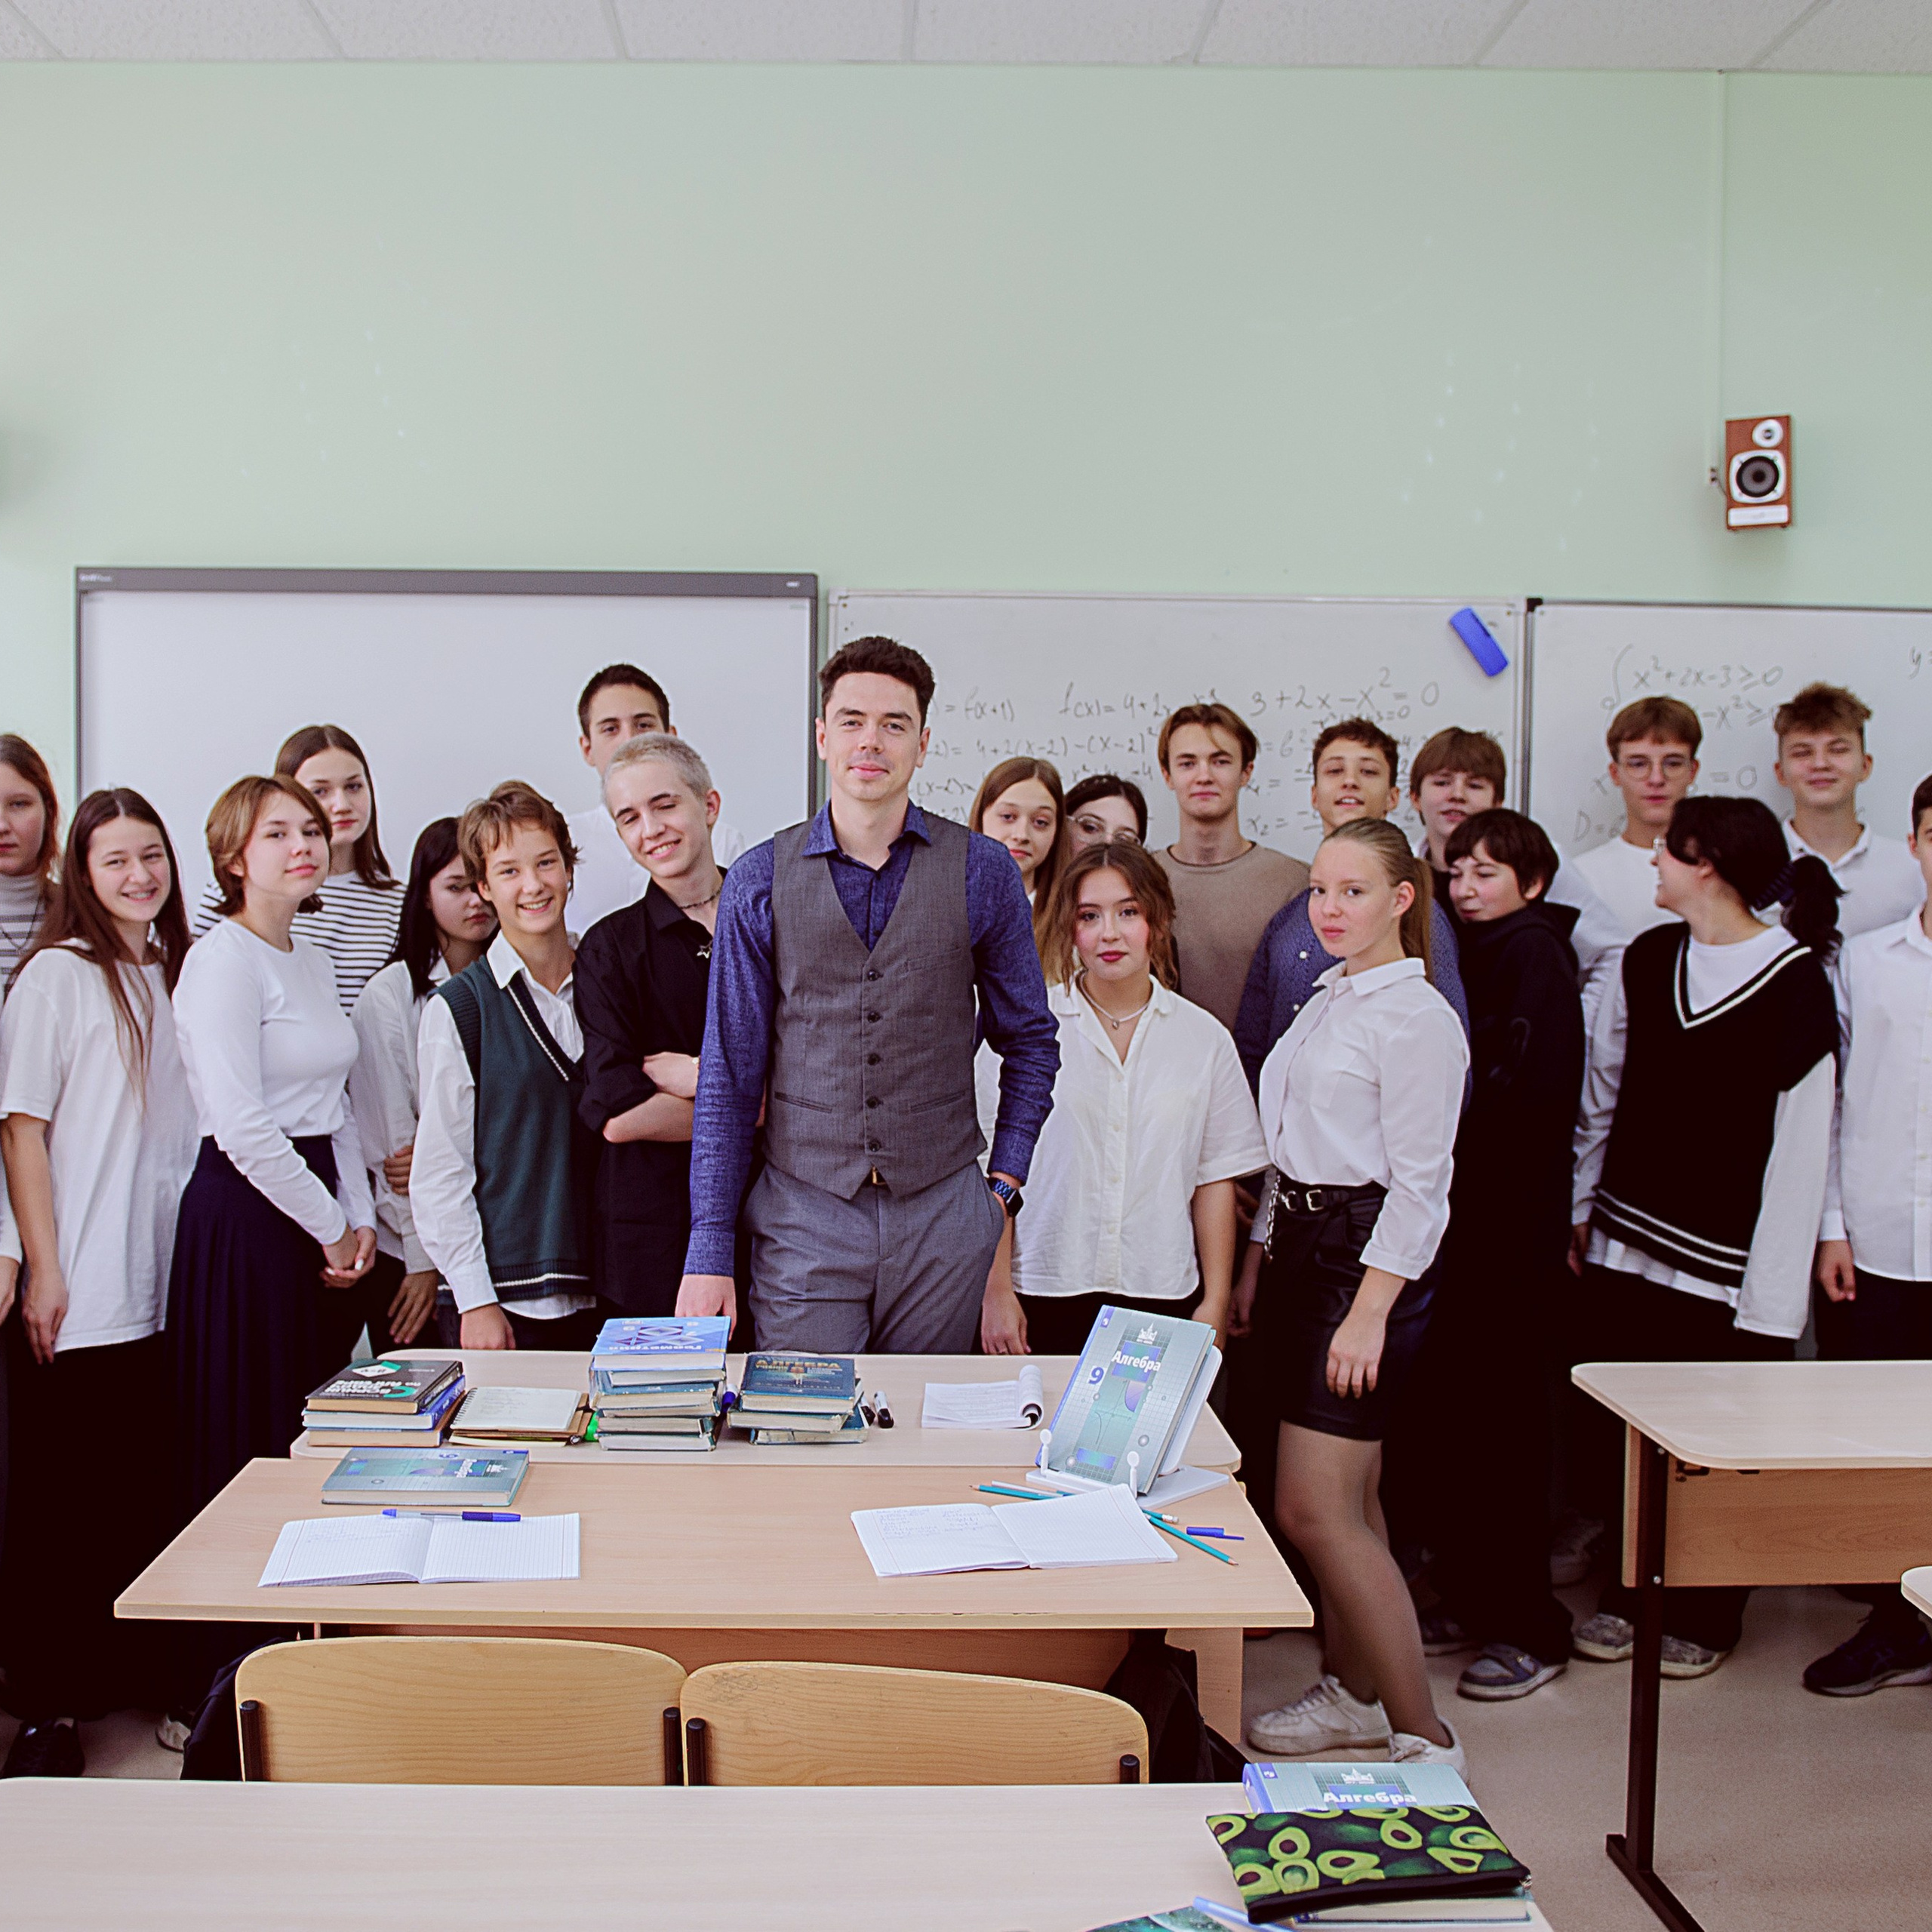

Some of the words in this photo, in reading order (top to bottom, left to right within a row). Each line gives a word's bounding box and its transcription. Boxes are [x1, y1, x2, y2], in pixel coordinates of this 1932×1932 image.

[1111, 1350, 1161, 1374] Алгебра
[1088, 1367, 1105, 1385] 9
[1323, 1792, 1417, 1805] Алгебра
